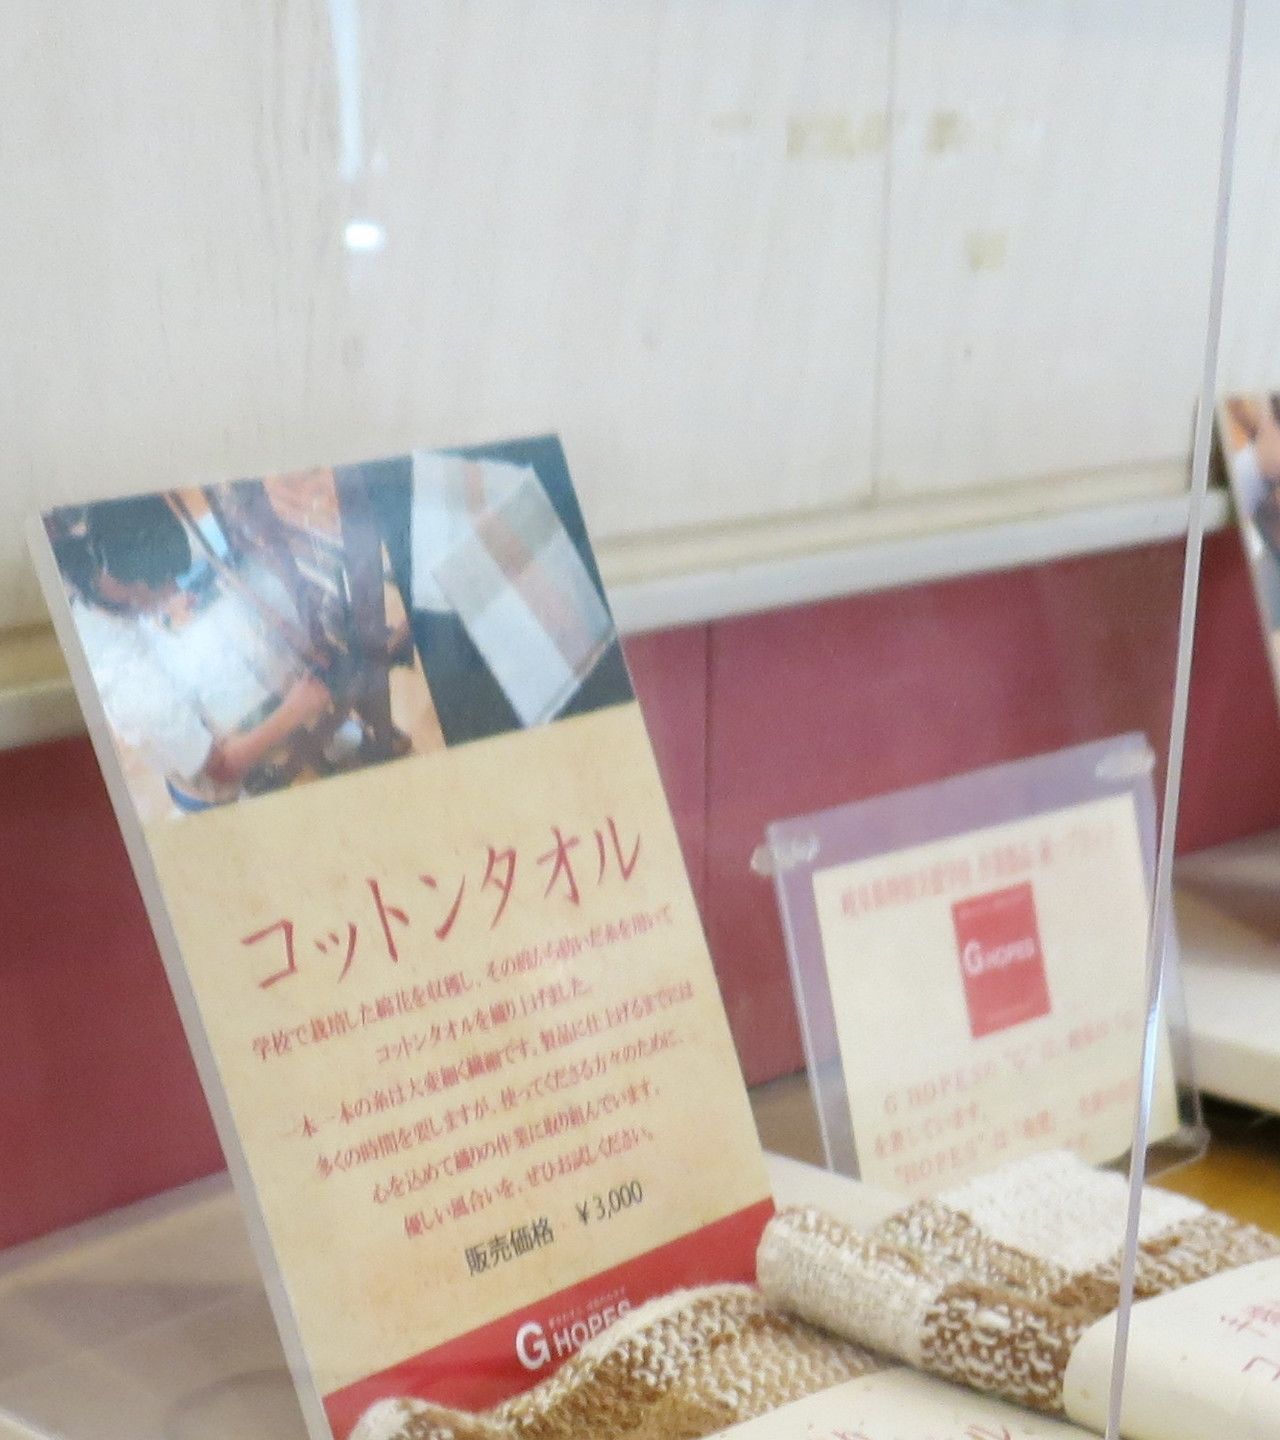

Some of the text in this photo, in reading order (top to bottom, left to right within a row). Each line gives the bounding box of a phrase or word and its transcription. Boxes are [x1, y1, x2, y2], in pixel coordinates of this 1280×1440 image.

[240, 816, 641, 990] コットンタオル
[465, 1214, 554, 1277] 販売価格
